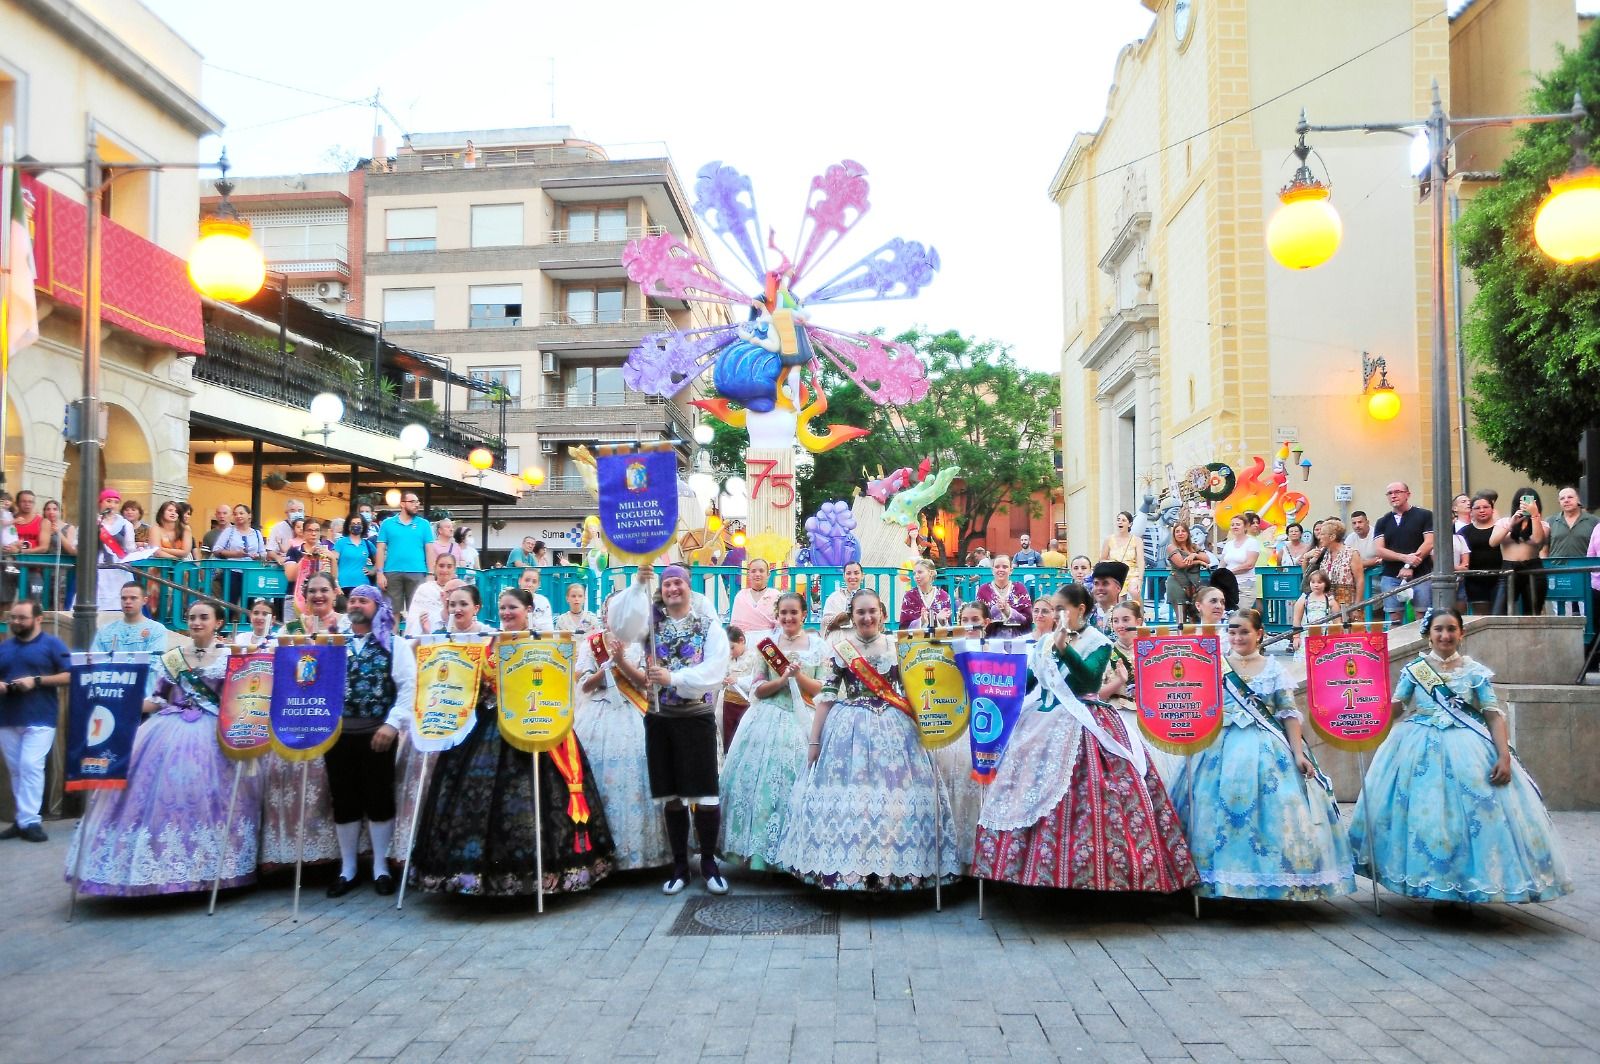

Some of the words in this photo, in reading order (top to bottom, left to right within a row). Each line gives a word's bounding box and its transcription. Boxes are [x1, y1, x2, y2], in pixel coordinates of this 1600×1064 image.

[744, 459, 794, 508] 75
[619, 500, 658, 510] MILLOR
[615, 510, 664, 520] FOGUERA
[617, 519, 664, 529] INFANTIL
[542, 530, 565, 539] Suma
[80, 671, 138, 686] PREMI
[95, 687, 125, 698] Punt
[287, 697, 327, 706] MILLOR
[1159, 702, 1201, 710] INDULTAT
[282, 708, 331, 716] FOGUERA
